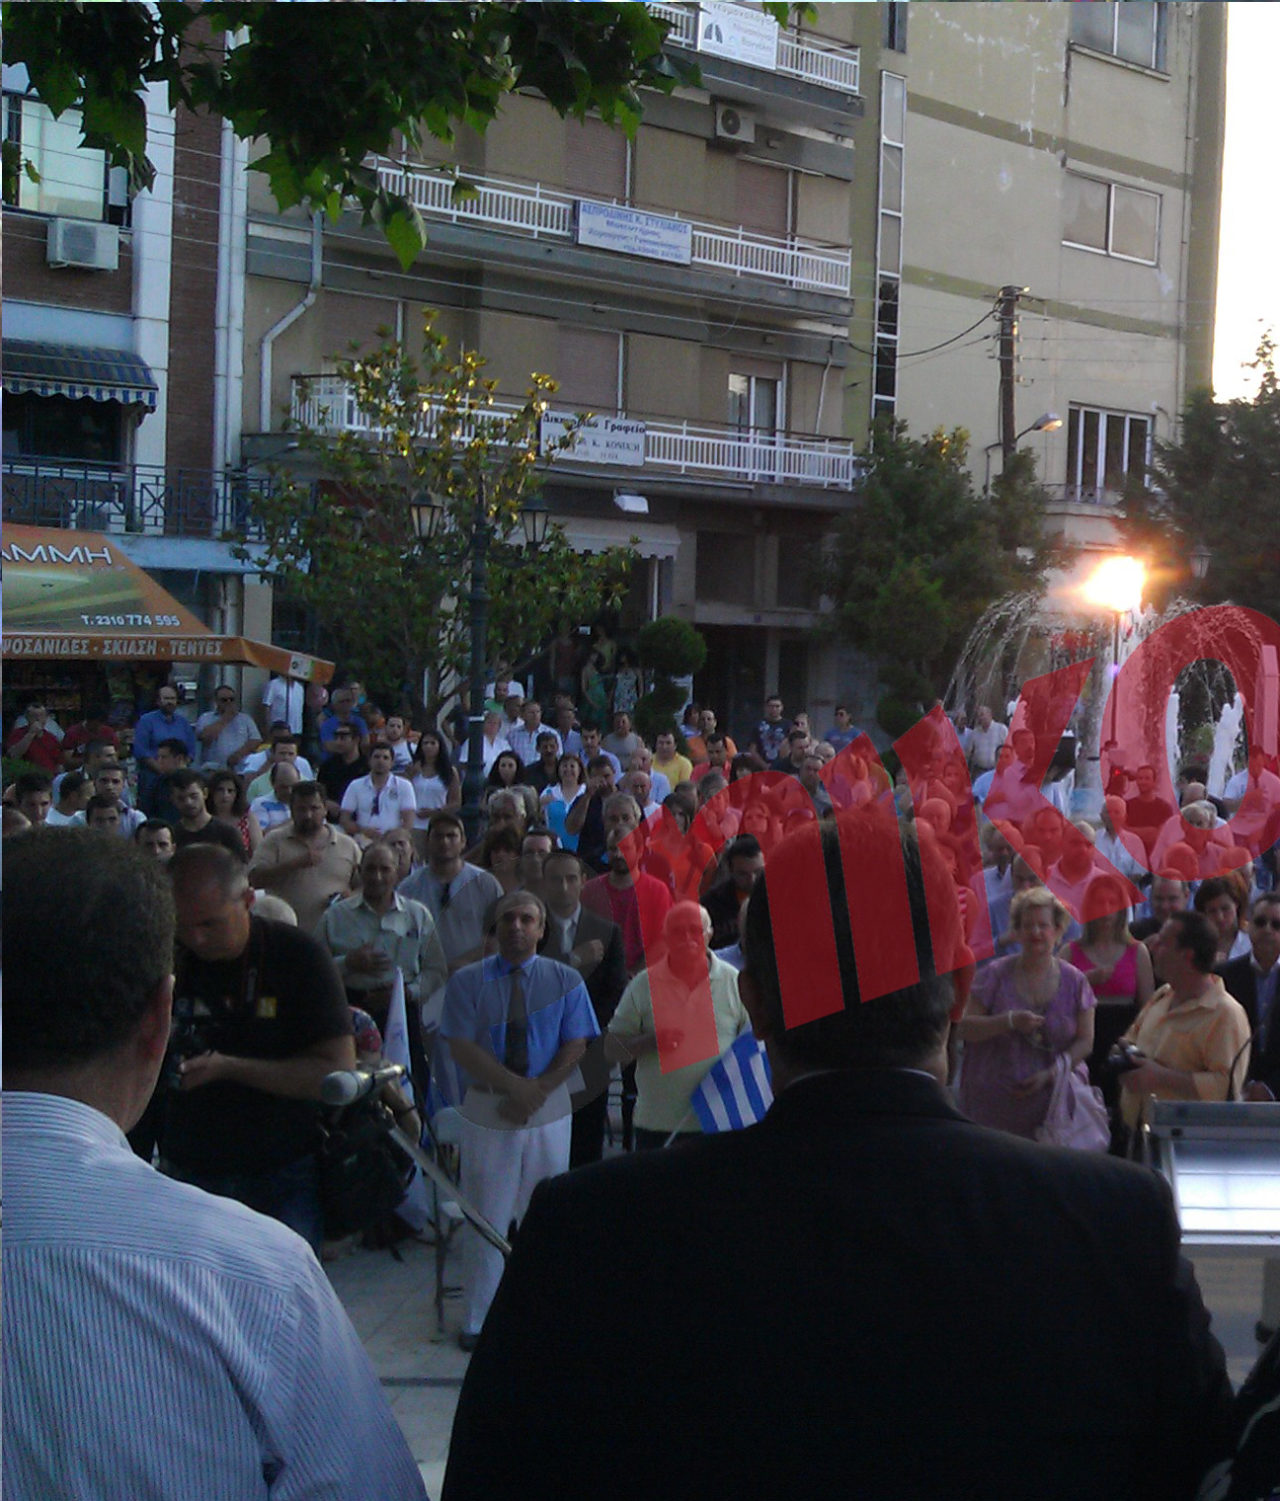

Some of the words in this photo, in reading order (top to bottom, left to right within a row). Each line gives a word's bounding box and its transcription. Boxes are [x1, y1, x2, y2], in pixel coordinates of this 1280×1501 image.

[125, 614, 152, 626] 774
[155, 615, 180, 627] 595
[102, 639, 156, 656] ΣΚΙΑΣΗ
[170, 640, 222, 656] ΤΕΝΤΕΣ
